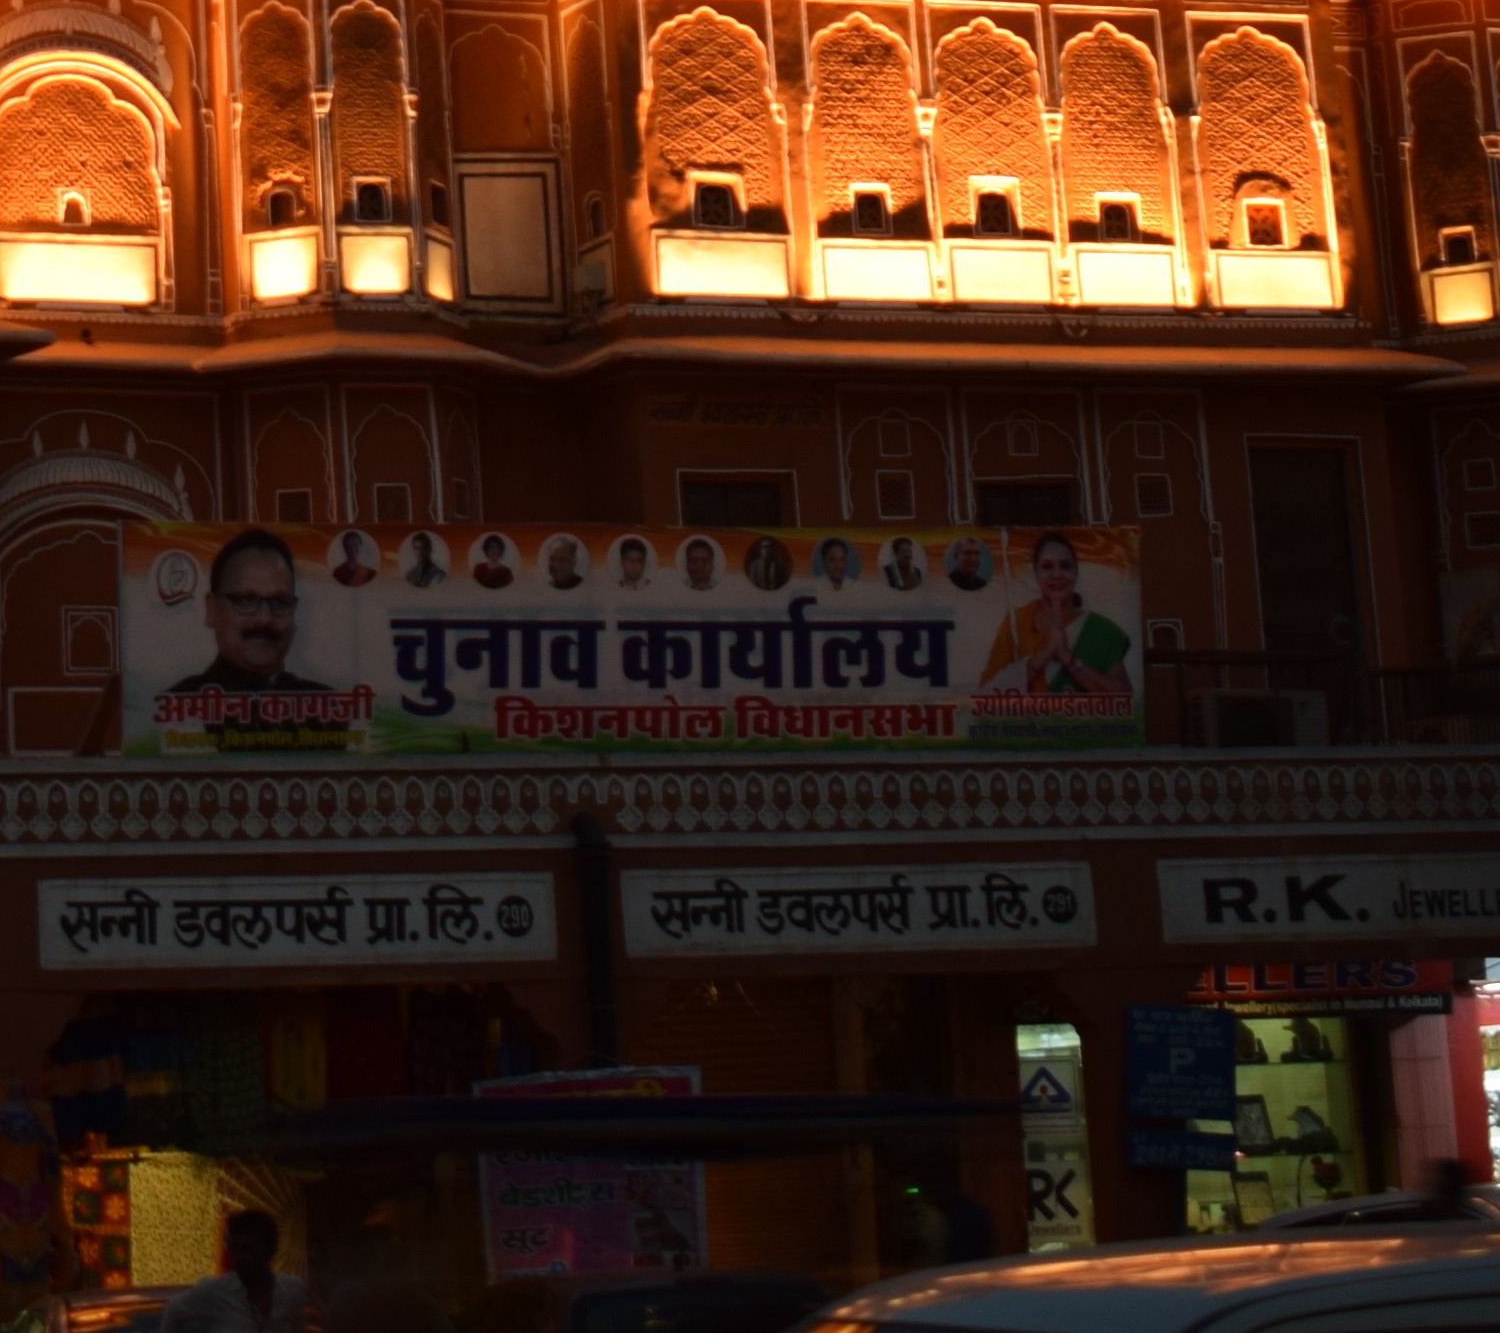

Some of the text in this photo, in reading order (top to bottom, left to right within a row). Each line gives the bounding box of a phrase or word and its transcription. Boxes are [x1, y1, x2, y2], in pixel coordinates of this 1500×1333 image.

[390, 596, 955, 717] चुनाव कार्यालय
[153, 683, 377, 725] अमीन कागजी
[494, 693, 957, 742] किशनपोल विधानसभा
[60, 888, 161, 953] सन्नी
[172, 885, 353, 948] डवलपर्स
[501, 904, 529, 927] 290
[650, 878, 747, 939] सन्नी
[756, 873, 914, 935] डवलपर्स
[1047, 892, 1073, 911] 291
[1202, 874, 1370, 924] R.K.
[1169, 1047, 1195, 1074] P
[501, 1227, 550, 1254] सूट
